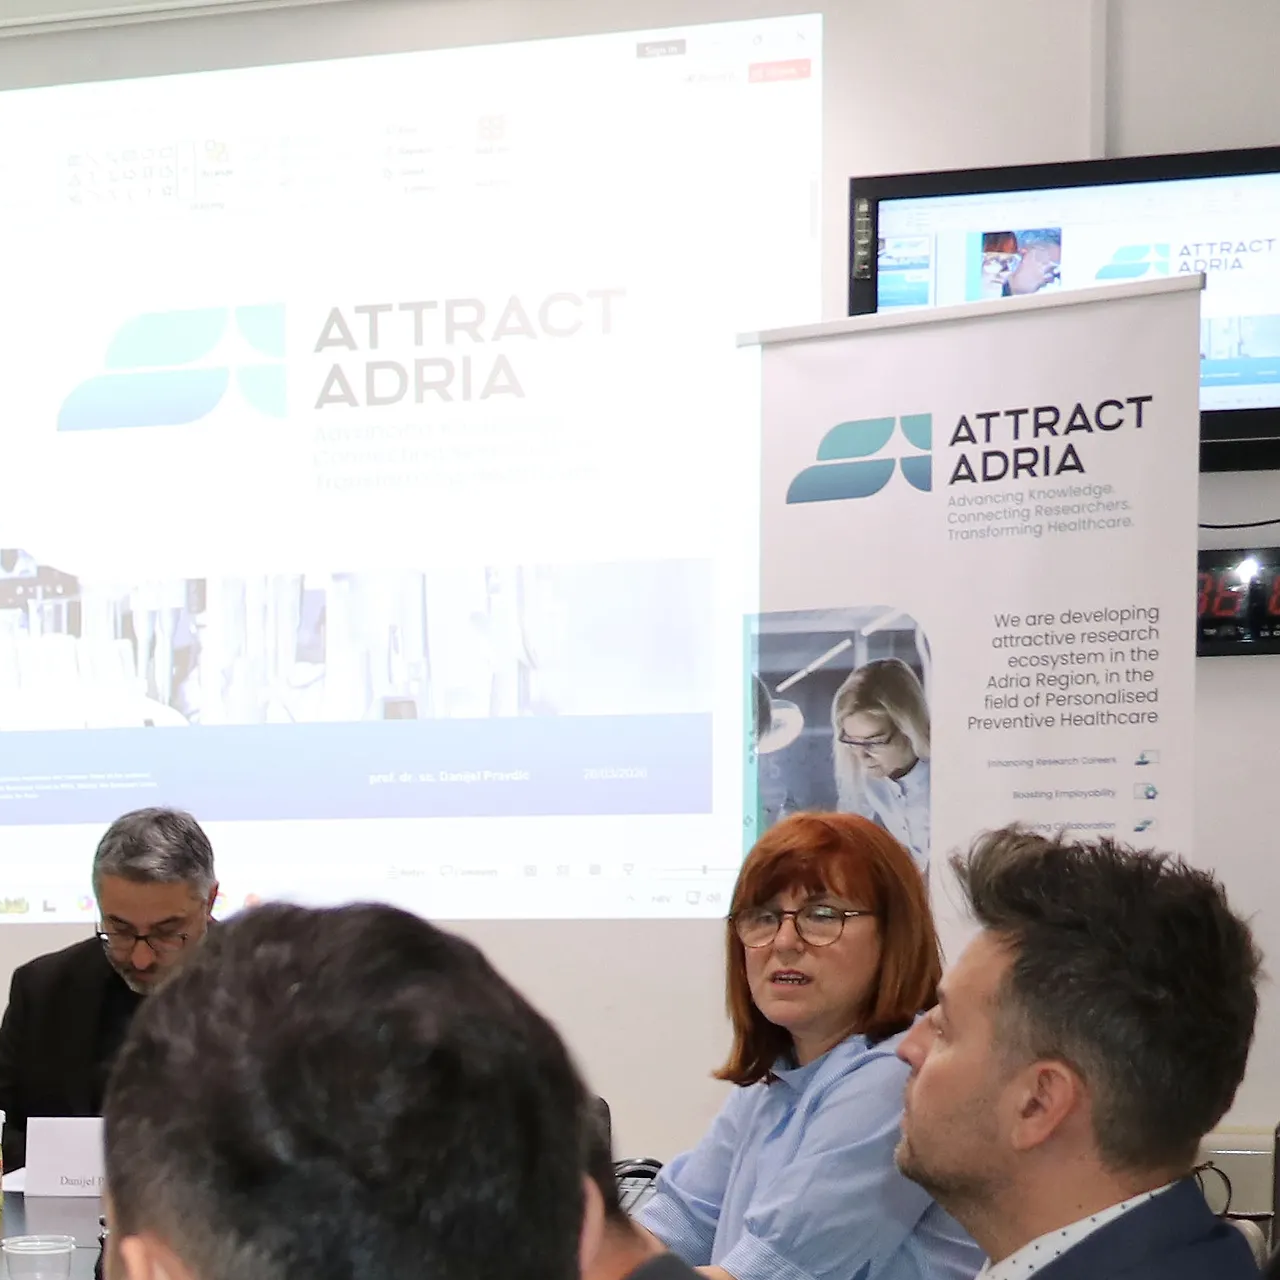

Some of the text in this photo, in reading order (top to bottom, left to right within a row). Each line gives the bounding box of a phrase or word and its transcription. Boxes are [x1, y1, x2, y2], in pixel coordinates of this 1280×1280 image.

[1179, 238, 1277, 257] ATTRACT
[1178, 257, 1243, 273] ADRIA
[313, 286, 627, 353] ATTRACT
[313, 353, 526, 410] ADRIA
[949, 395, 1153, 447] ATTRACT
[949, 443, 1086, 485] ADRIA
[948, 483, 1115, 508] Advancing Knowledge.
[947, 499, 1131, 524] Connecting Researchers.
[948, 516, 1135, 541] Transforming Healthcare.
[994, 606, 1160, 628] We are developing
[992, 626, 1159, 649] attractive research
[1008, 647, 1159, 670] ecosystem in the
[987, 668, 1154, 690] Adria Region, in the
[984, 688, 1158, 710] field of Personalised
[968, 709, 1158, 730] Preventive Healthcare
[1013, 788, 1116, 800] Boosting Employability
[60, 1175, 95, 1188] Danijel
